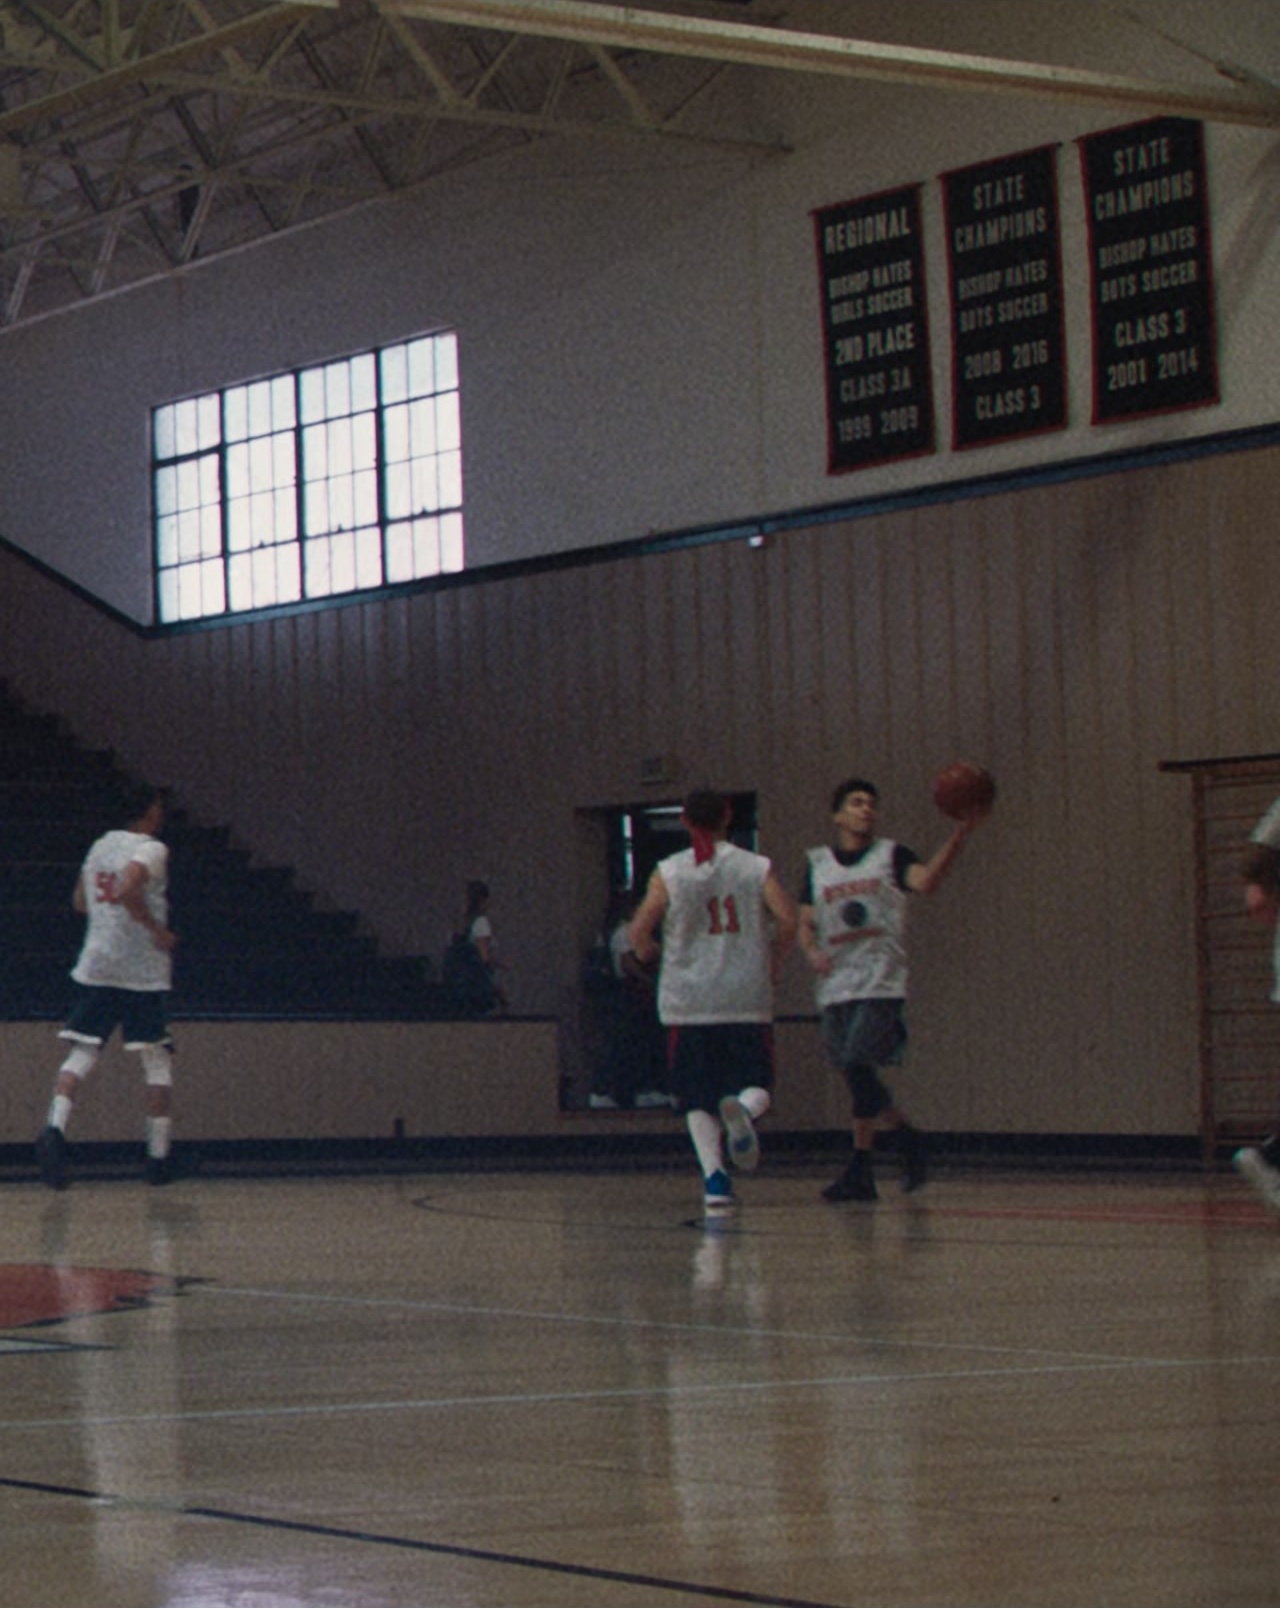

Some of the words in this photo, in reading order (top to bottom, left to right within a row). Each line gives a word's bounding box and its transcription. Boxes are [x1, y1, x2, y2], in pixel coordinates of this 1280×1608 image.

[1113, 136, 1169, 177] STATE
[972, 174, 1025, 211] STATE
[1095, 169, 1194, 221] CHAMPIONS
[824, 206, 911, 255] REGIONAL
[954, 206, 1047, 254] CHAMPIONS
[1098, 237, 1147, 270] BISHOP
[1149, 225, 1197, 257] HAYES
[958, 269, 1004, 301] BISHOP
[1005, 258, 1048, 288] HAYES
[1101, 273, 1137, 304] BOYS
[1141, 259, 1199, 293] SOCCER
[867, 285, 914, 317] SOCCER
[960, 304, 994, 333] BOYS
[997, 291, 1049, 324] SOCCER
[835, 335, 864, 366] 2ND
[867, 321, 916, 358] PLACE
[1114, 311, 1170, 348] CLASS
[1174, 307, 1188, 335] 3
[1012, 339, 1049, 370] 2016
[1107, 357, 1148, 391] 2001
[1158, 346, 1199, 380] 2014
[840, 371, 887, 403] CLASS
[890, 366, 913, 393] 3A
[975, 387, 1027, 421] CLASS
[1029, 384, 1042, 411] 3
[837, 414, 873, 443] 1999
[707, 894, 740, 935] 11
